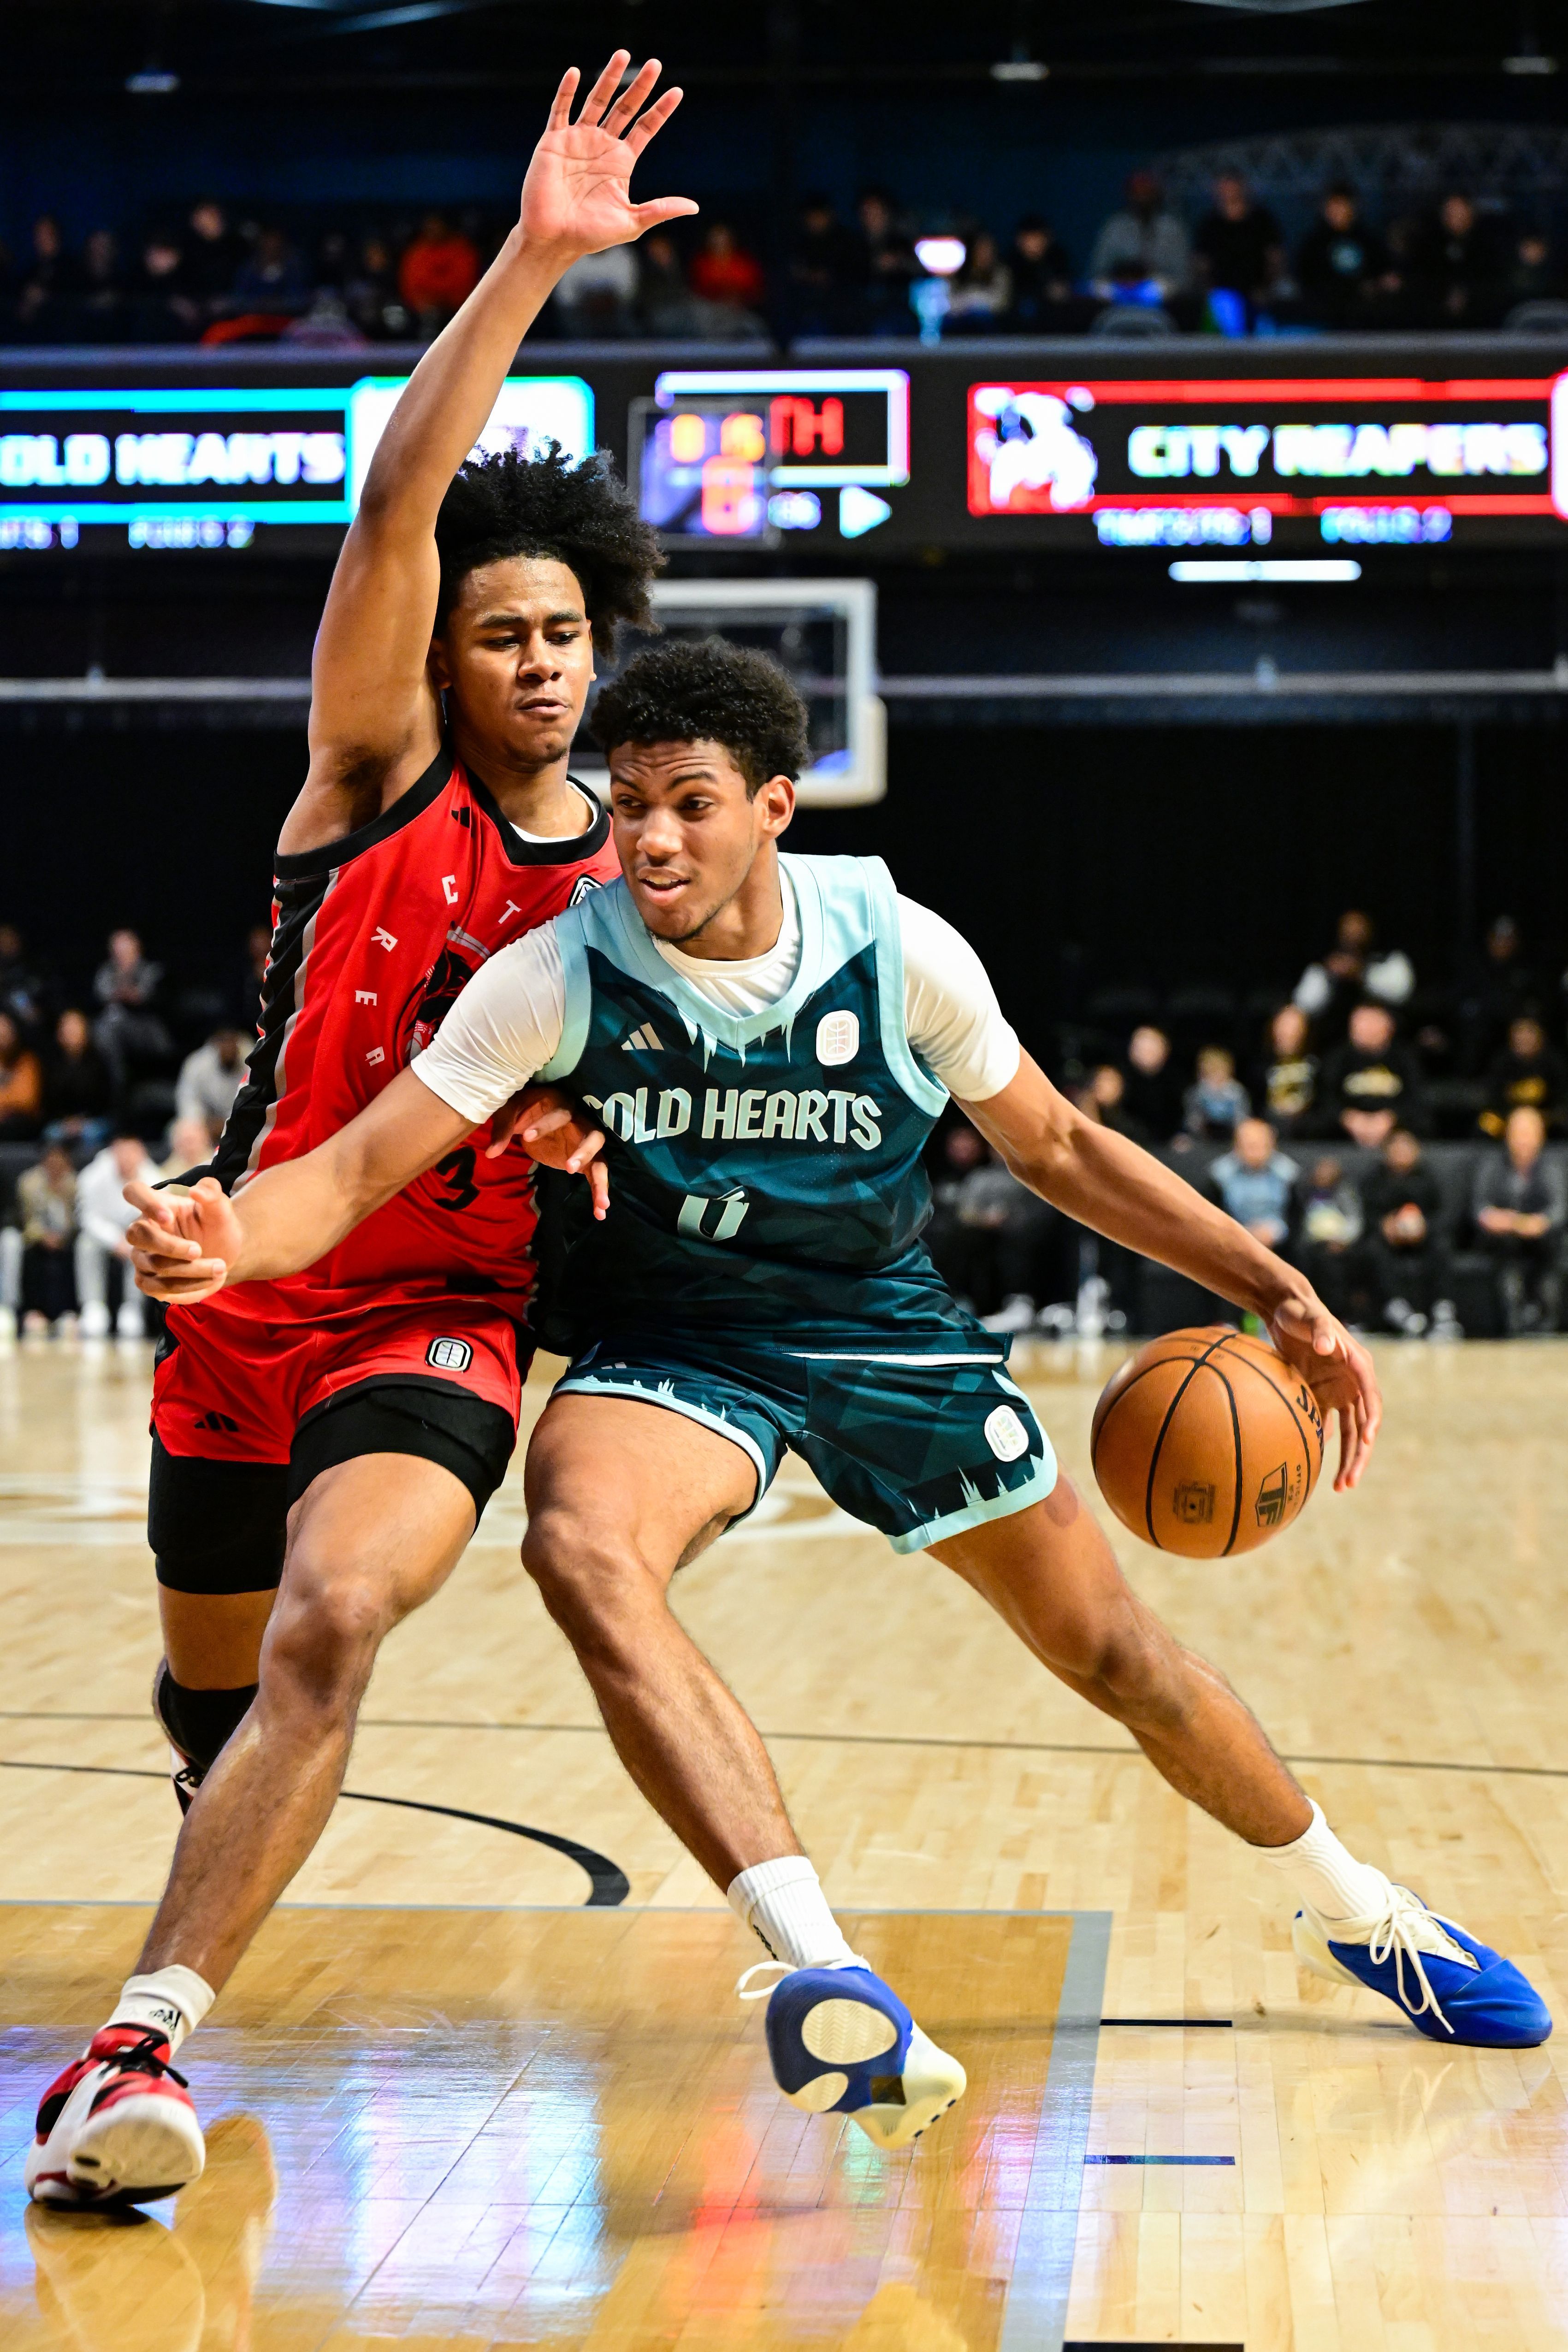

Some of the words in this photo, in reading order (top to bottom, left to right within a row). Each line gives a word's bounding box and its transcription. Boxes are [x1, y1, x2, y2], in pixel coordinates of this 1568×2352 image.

[115, 432, 345, 485] HEARTS
[1128, 425, 1271, 478] CITY
[1273, 424, 1548, 477] REAPERS
[701, 1088, 882, 1151] HEARTS
